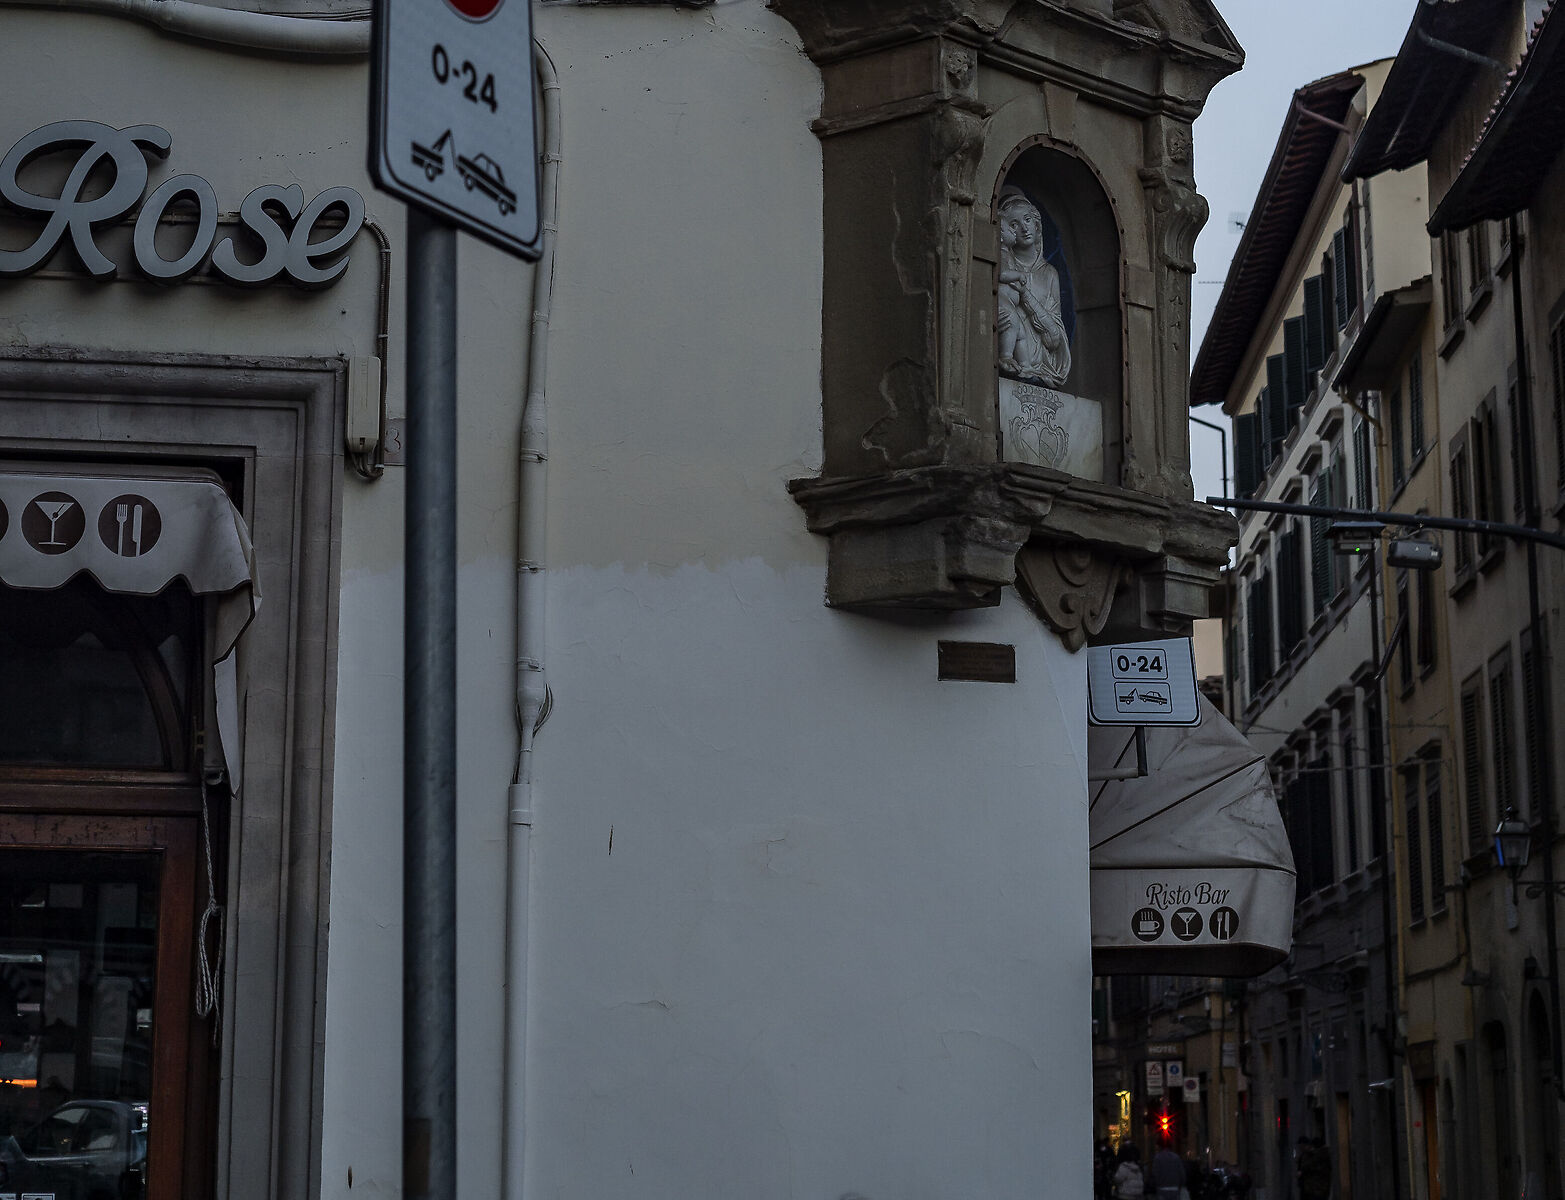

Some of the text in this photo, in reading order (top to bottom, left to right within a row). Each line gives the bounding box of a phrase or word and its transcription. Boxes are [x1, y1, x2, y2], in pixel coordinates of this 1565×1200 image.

[432, 43, 498, 114] 0-24
[0, 120, 366, 287] Rose
[1117, 655, 1163, 673] 0-24
[1146, 882, 1230, 910] Risto Bar
